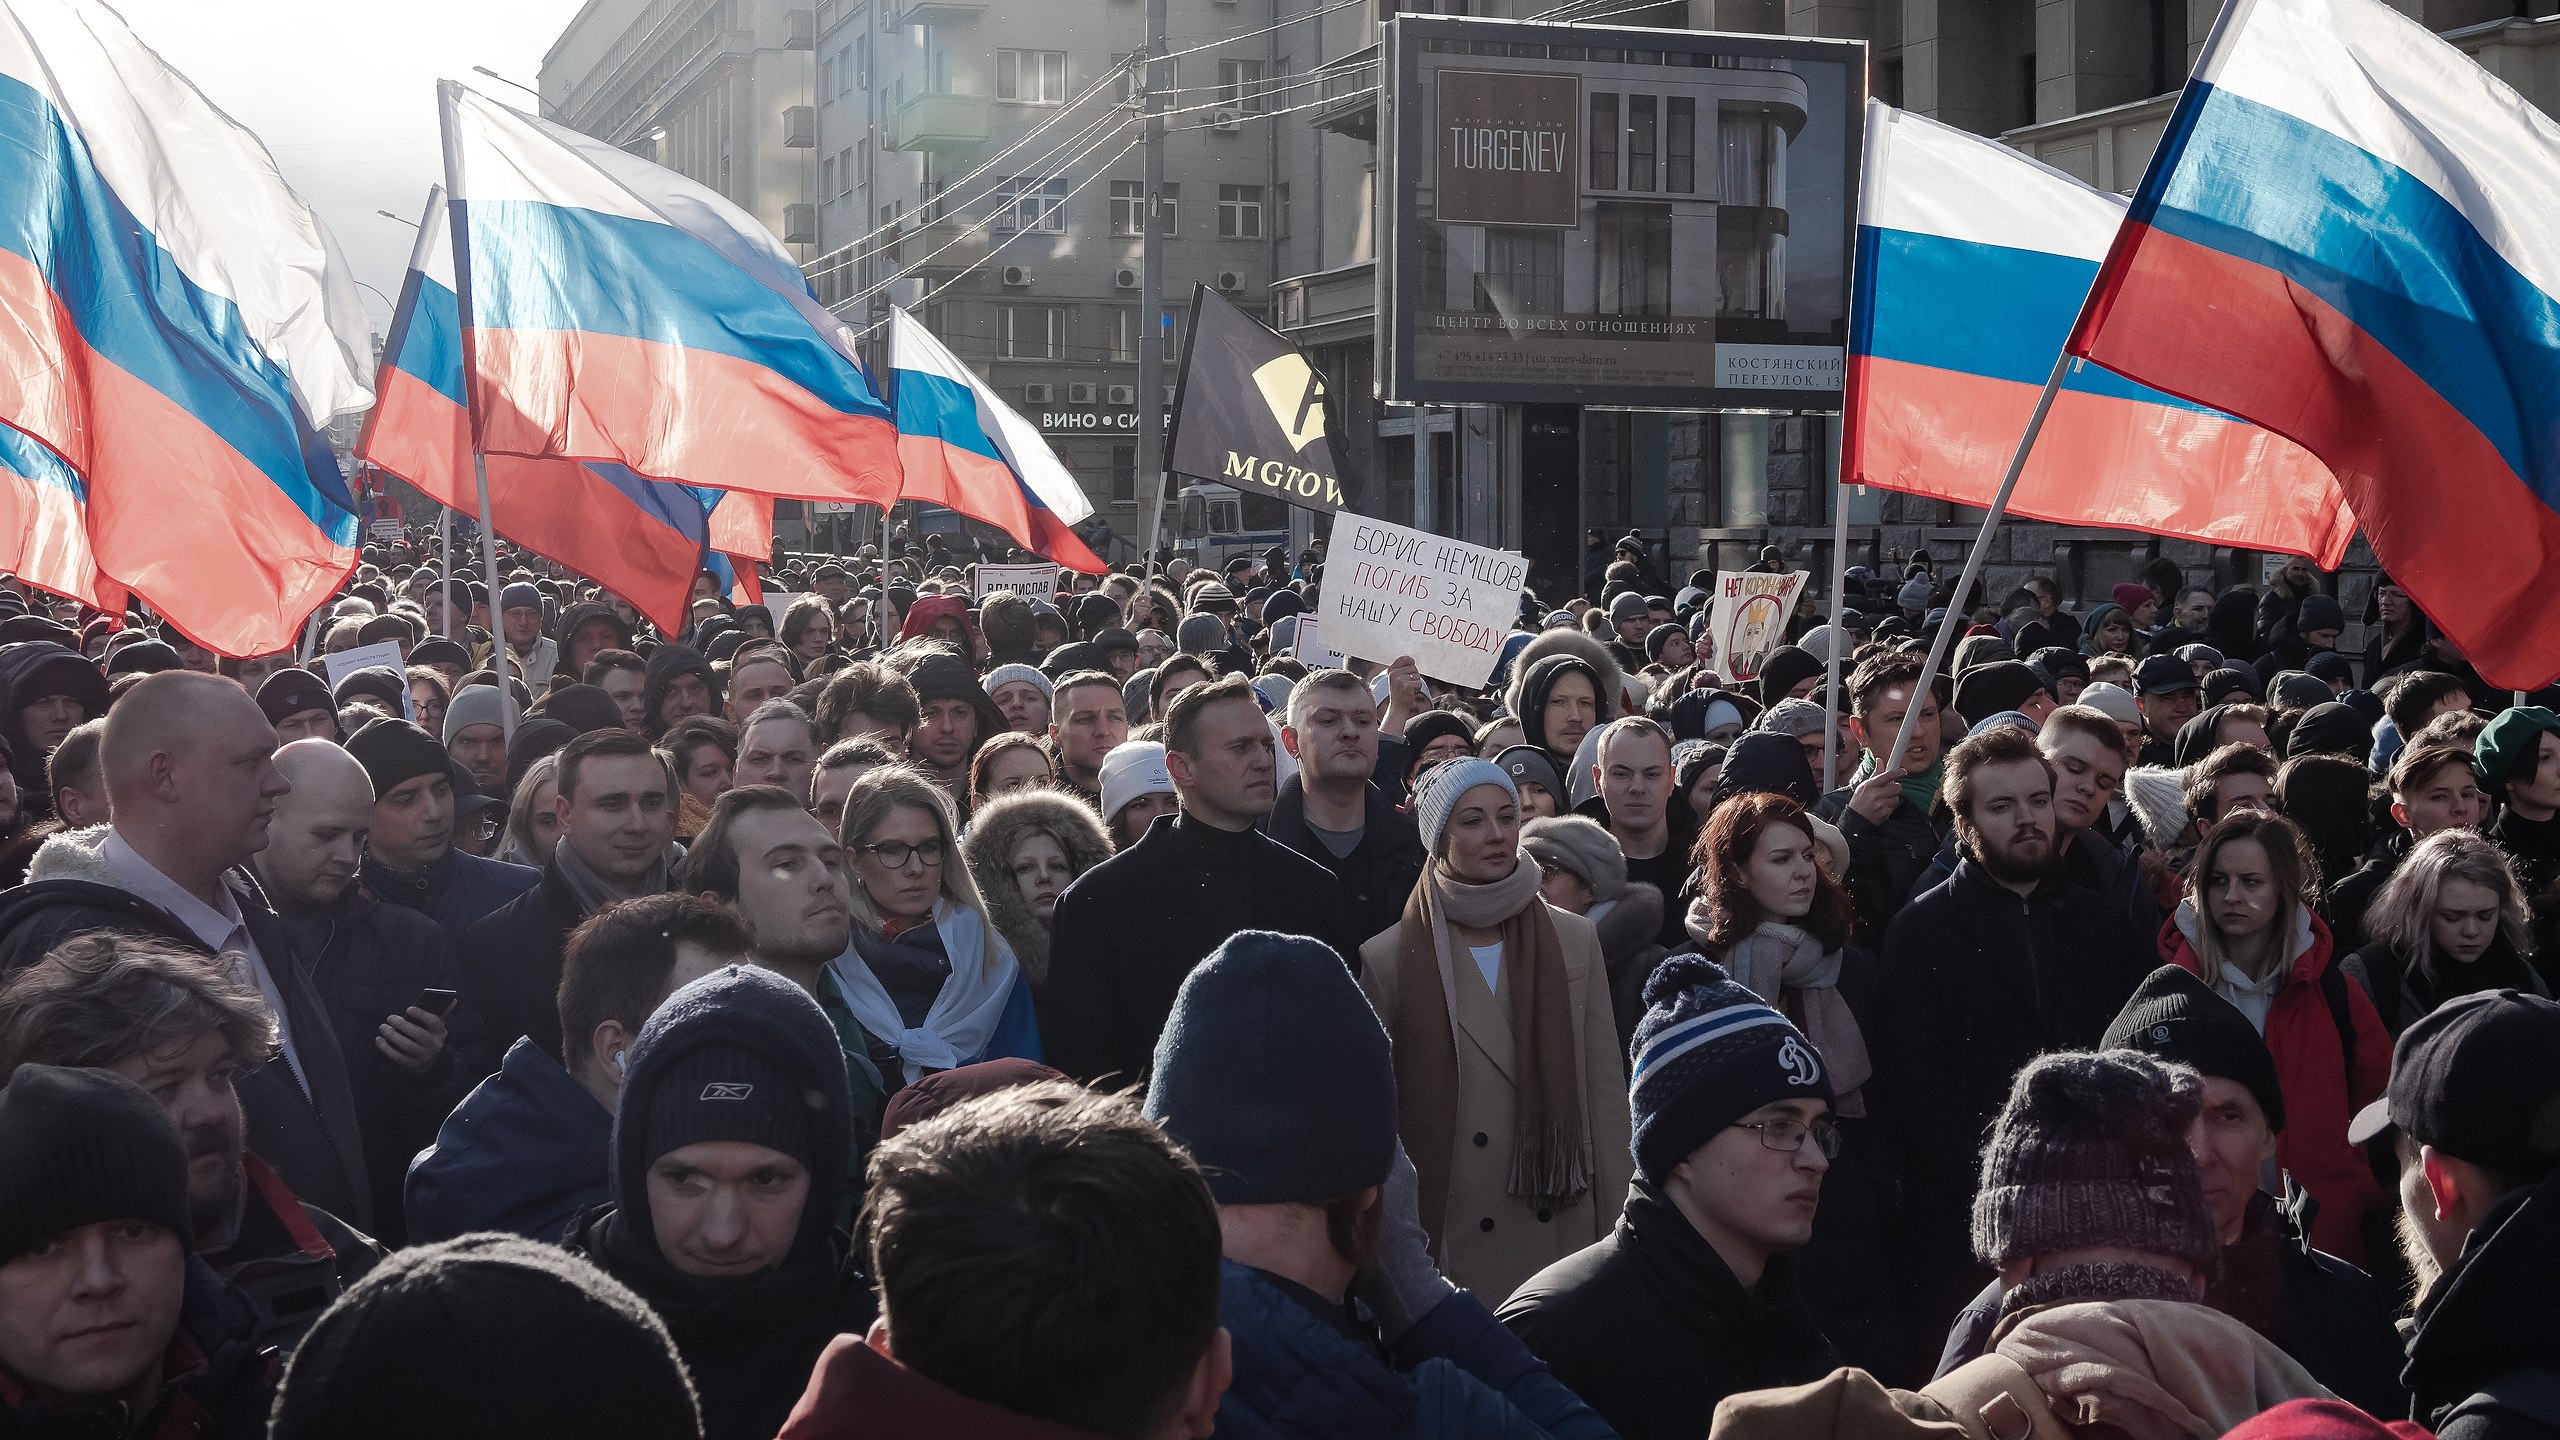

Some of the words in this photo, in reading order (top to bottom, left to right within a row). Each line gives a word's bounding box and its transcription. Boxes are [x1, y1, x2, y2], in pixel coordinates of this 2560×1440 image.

[1450, 127, 1566, 173] TURGENEV
[1435, 315, 1491, 329] ЦЕНТР
[1498, 318, 1519, 330] ВО
[1526, 319, 1568, 331] ВСЕХ
[1575, 320, 1696, 335] ОТНОШЕНИЯХ
[1728, 357, 1840, 371] КОСТЯНСКИЙ
[1729, 373, 1819, 388] ПЕРЕУЛОК,
[1826, 376, 1840, 387] 13
[1043, 412, 1097, 428] ВИНО
[1223, 450, 1344, 507] MGTOW
[1353, 525, 1427, 566] БОРИС
[1434, 545, 1521, 592] НЕМЦОВ
[1353, 561, 1432, 600] ПОГИБ
[1441, 582, 1472, 611] ЗА
[1725, 577, 1743, 598] НЕТ
[1339, 594, 1402, 626] НАШУ
[1409, 609, 1508, 655] СВОБОДУ
